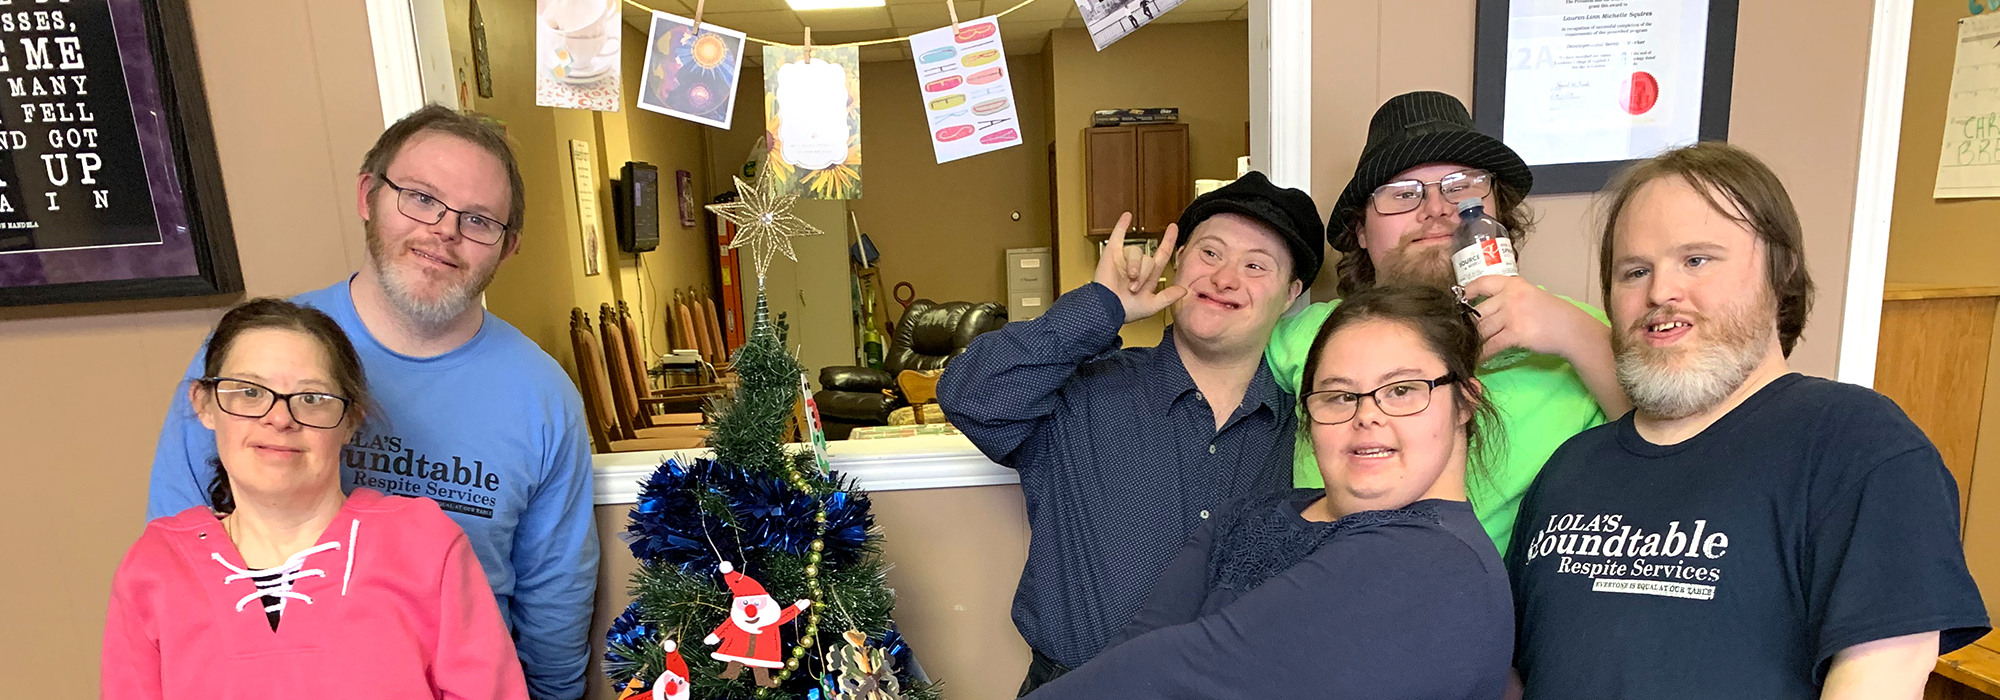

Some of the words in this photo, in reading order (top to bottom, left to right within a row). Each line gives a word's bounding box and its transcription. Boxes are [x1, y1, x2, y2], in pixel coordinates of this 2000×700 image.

[19, 36, 85, 70] ME
[6, 75, 88, 97] MANY
[20, 102, 94, 123] FELL
[48, 127, 98, 148] GOT
[40, 152, 102, 187] UP
[7, 221, 40, 229] MANDELA
[351, 430, 402, 453] LA'S
[353, 471, 421, 494] Respite
[425, 481, 496, 507] Services
[1546, 513, 1624, 534] LOLA'S
[1557, 556, 1627, 579] Respite
[1631, 558, 1721, 583] Services
[1595, 581, 1629, 589] EVERYONE
[1637, 582, 1658, 591] EQUAL
[1658, 583, 1668, 592] AT
[1669, 584, 1685, 593] OUR
[1687, 587, 1712, 596] TABLE
